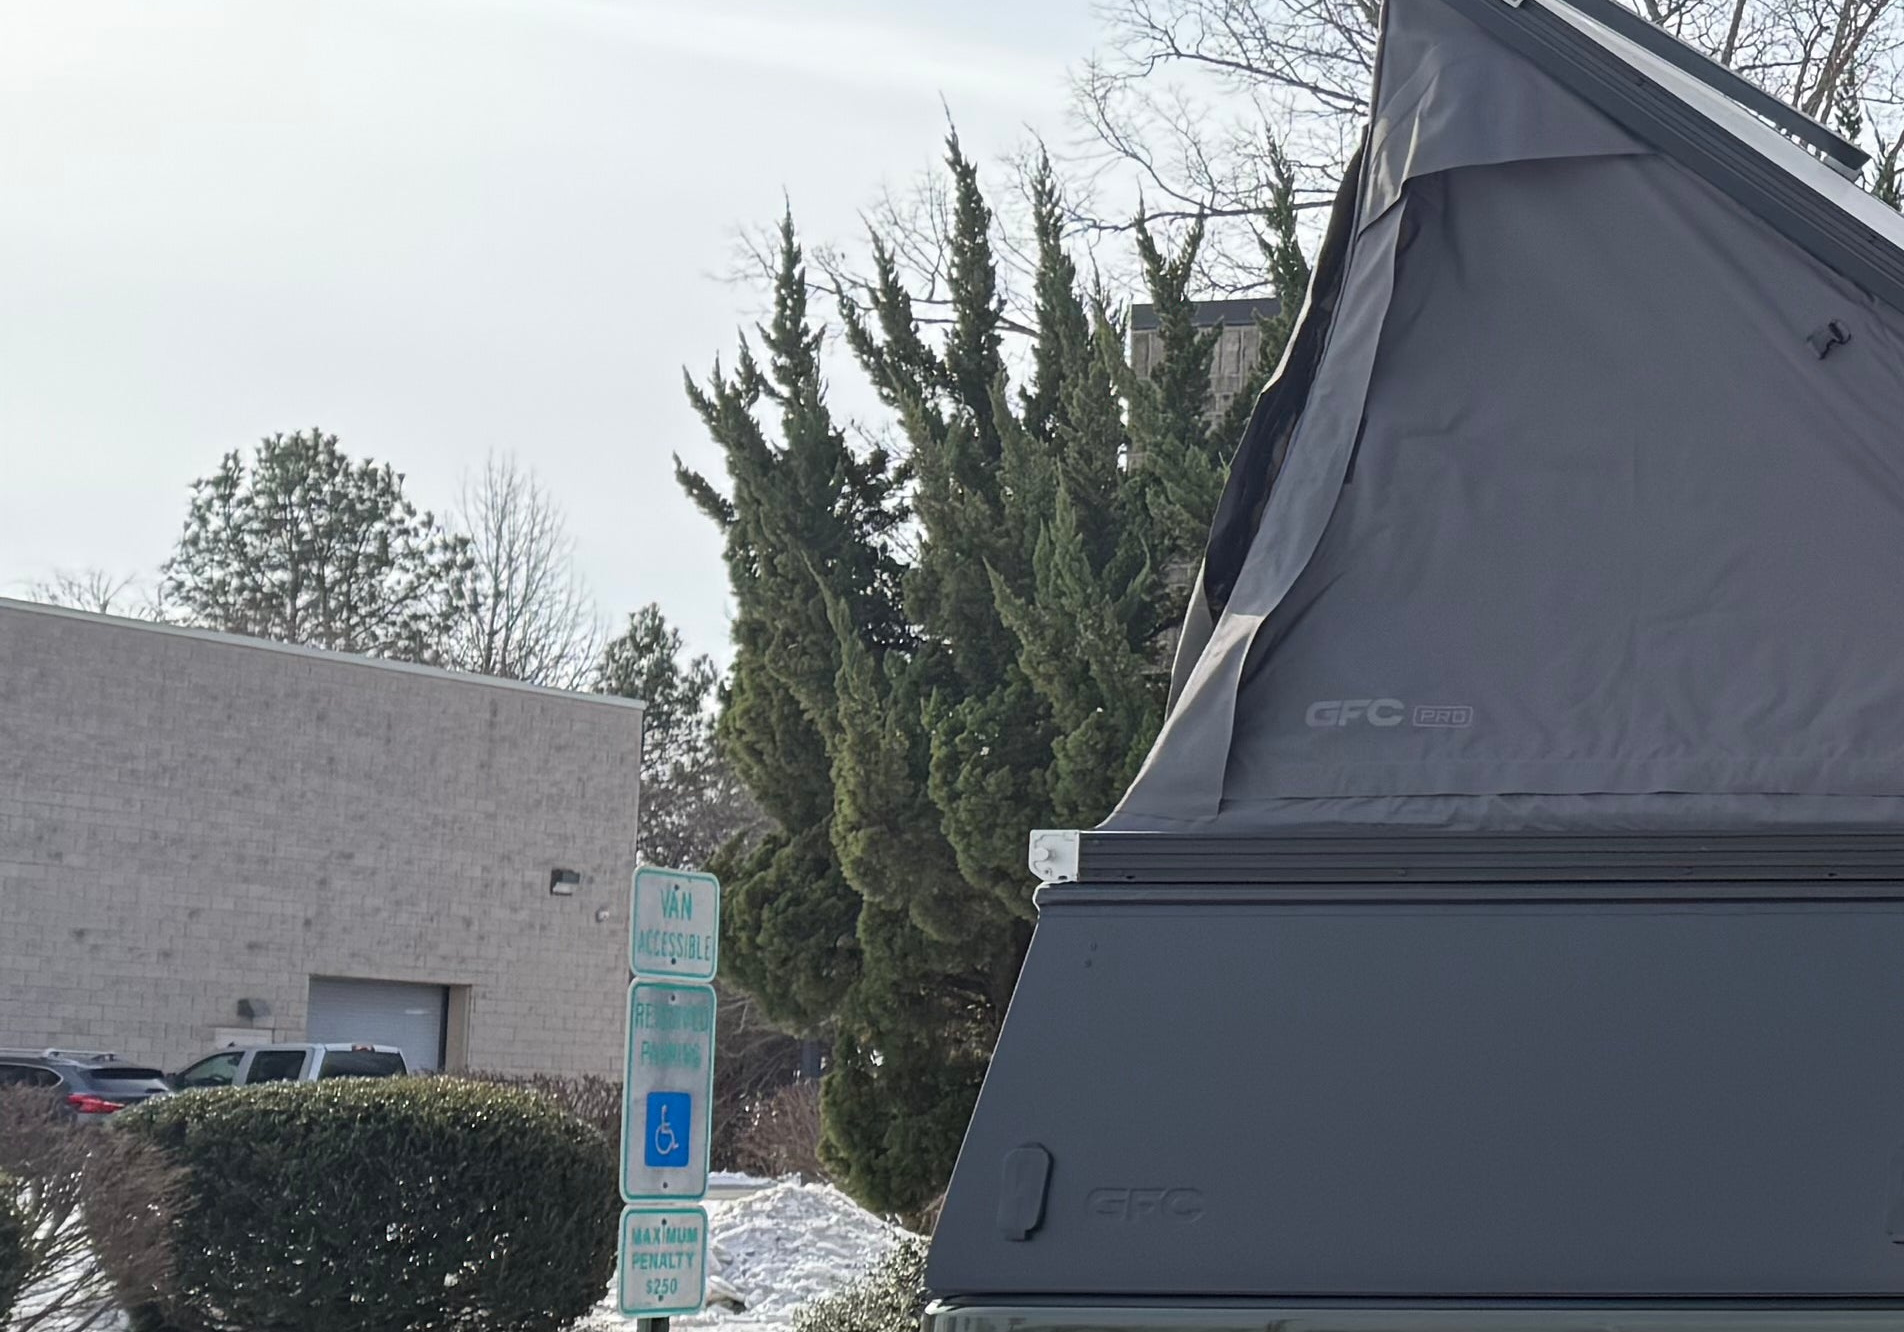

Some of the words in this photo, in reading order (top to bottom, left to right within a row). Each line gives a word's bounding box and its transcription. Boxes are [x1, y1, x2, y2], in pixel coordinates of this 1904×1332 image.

[1305, 698, 1405, 727] GFC
[1420, 710, 1467, 724] PRO
[661, 889, 693, 921] VAN
[638, 928, 711, 962] ACCESSIBLE
[632, 1227, 698, 1245] MAXIMUM
[632, 1252, 695, 1270] PENALTY
[646, 1278, 678, 1295] $250
